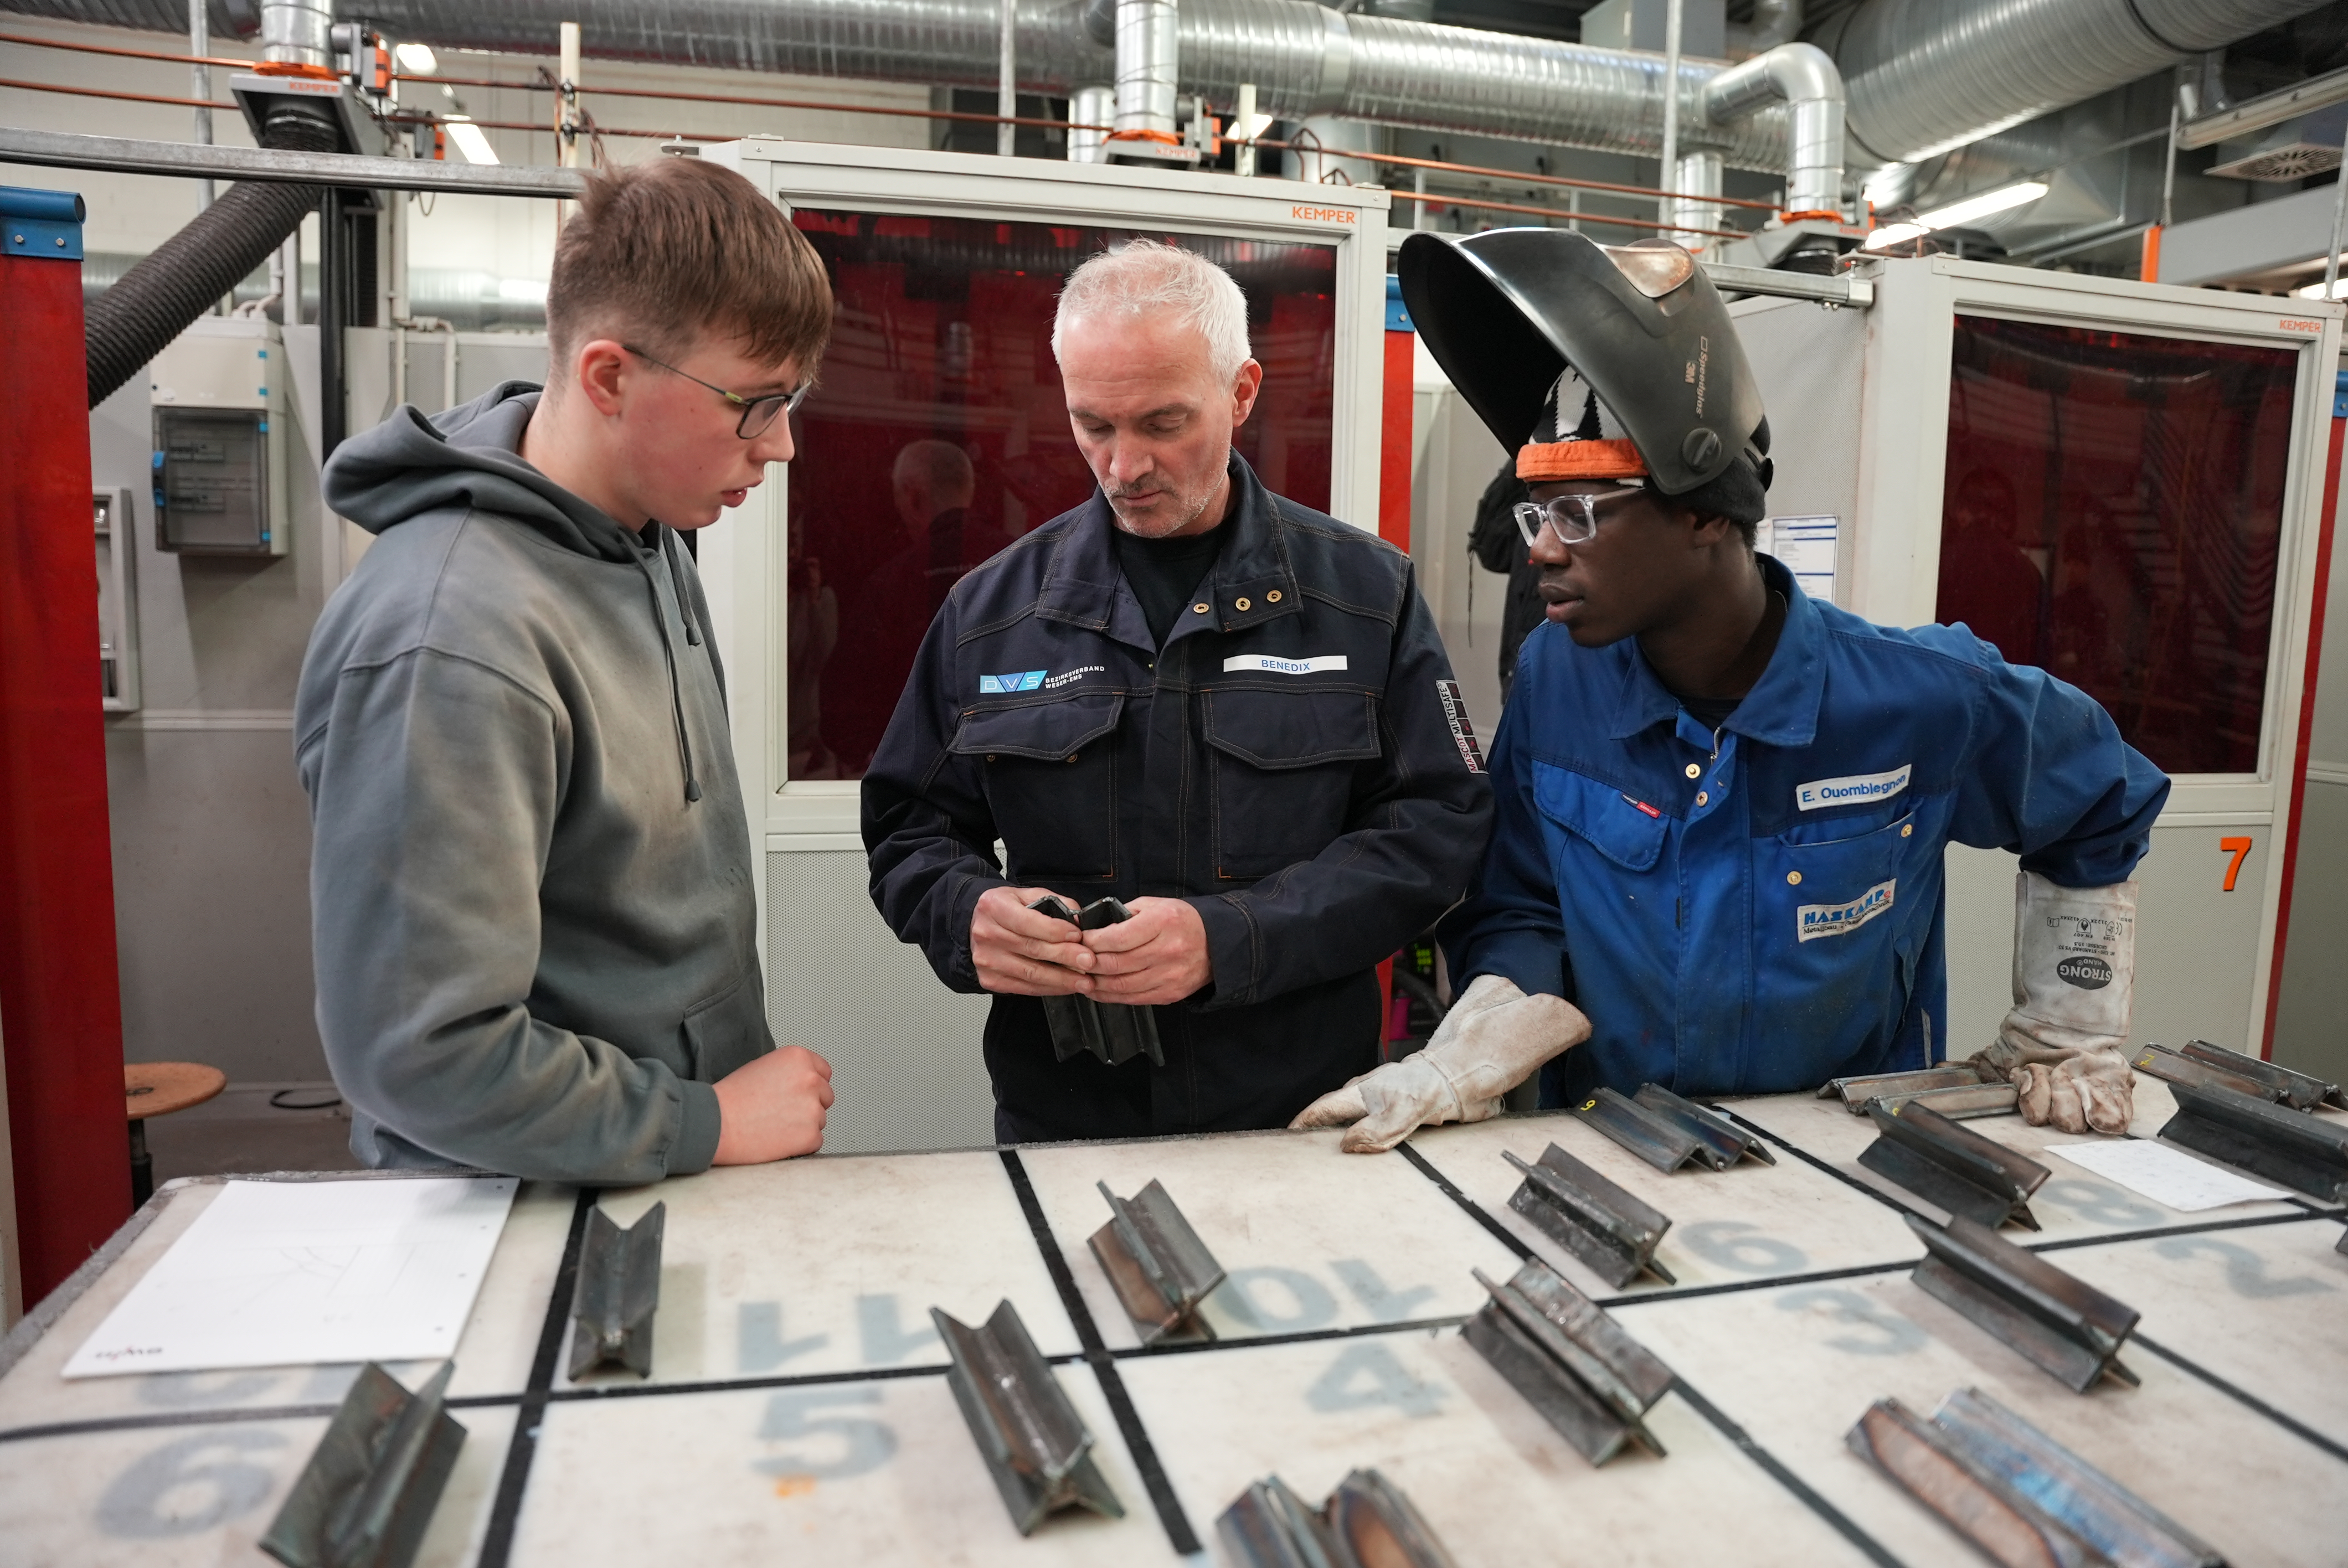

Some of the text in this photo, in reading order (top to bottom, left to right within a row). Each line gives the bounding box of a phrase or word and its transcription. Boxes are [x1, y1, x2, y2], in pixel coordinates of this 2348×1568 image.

[1292, 206, 1356, 224] KEMPER
[2279, 319, 2321, 333] KEMPER
[1685, 362, 1696, 384] 3M
[1045, 666, 1105, 684] BEZIRKSVERBAND
[1261, 659, 1311, 672] BENEDIX
[984, 675, 1039, 691] DVS
[1045, 674, 1083, 689] WESER-EMS
[1456, 737, 1477, 771] MASCOT
[1802, 774, 1906, 802] E. Ouomblegnon
[2220, 836, 2252, 891] 7
[1804, 889, 1884, 925] HASKAMP
[1803, 925, 1837, 935] Metallbau
[2059, 964, 2112, 982] STRONG
[1580, 1100, 1596, 1111] 9
[1773, 1287, 1927, 1355] 3
[1304, 1342, 1451, 1418] 4
[750, 1386, 900, 1482] 5
[95, 1428, 292, 1540] 6
